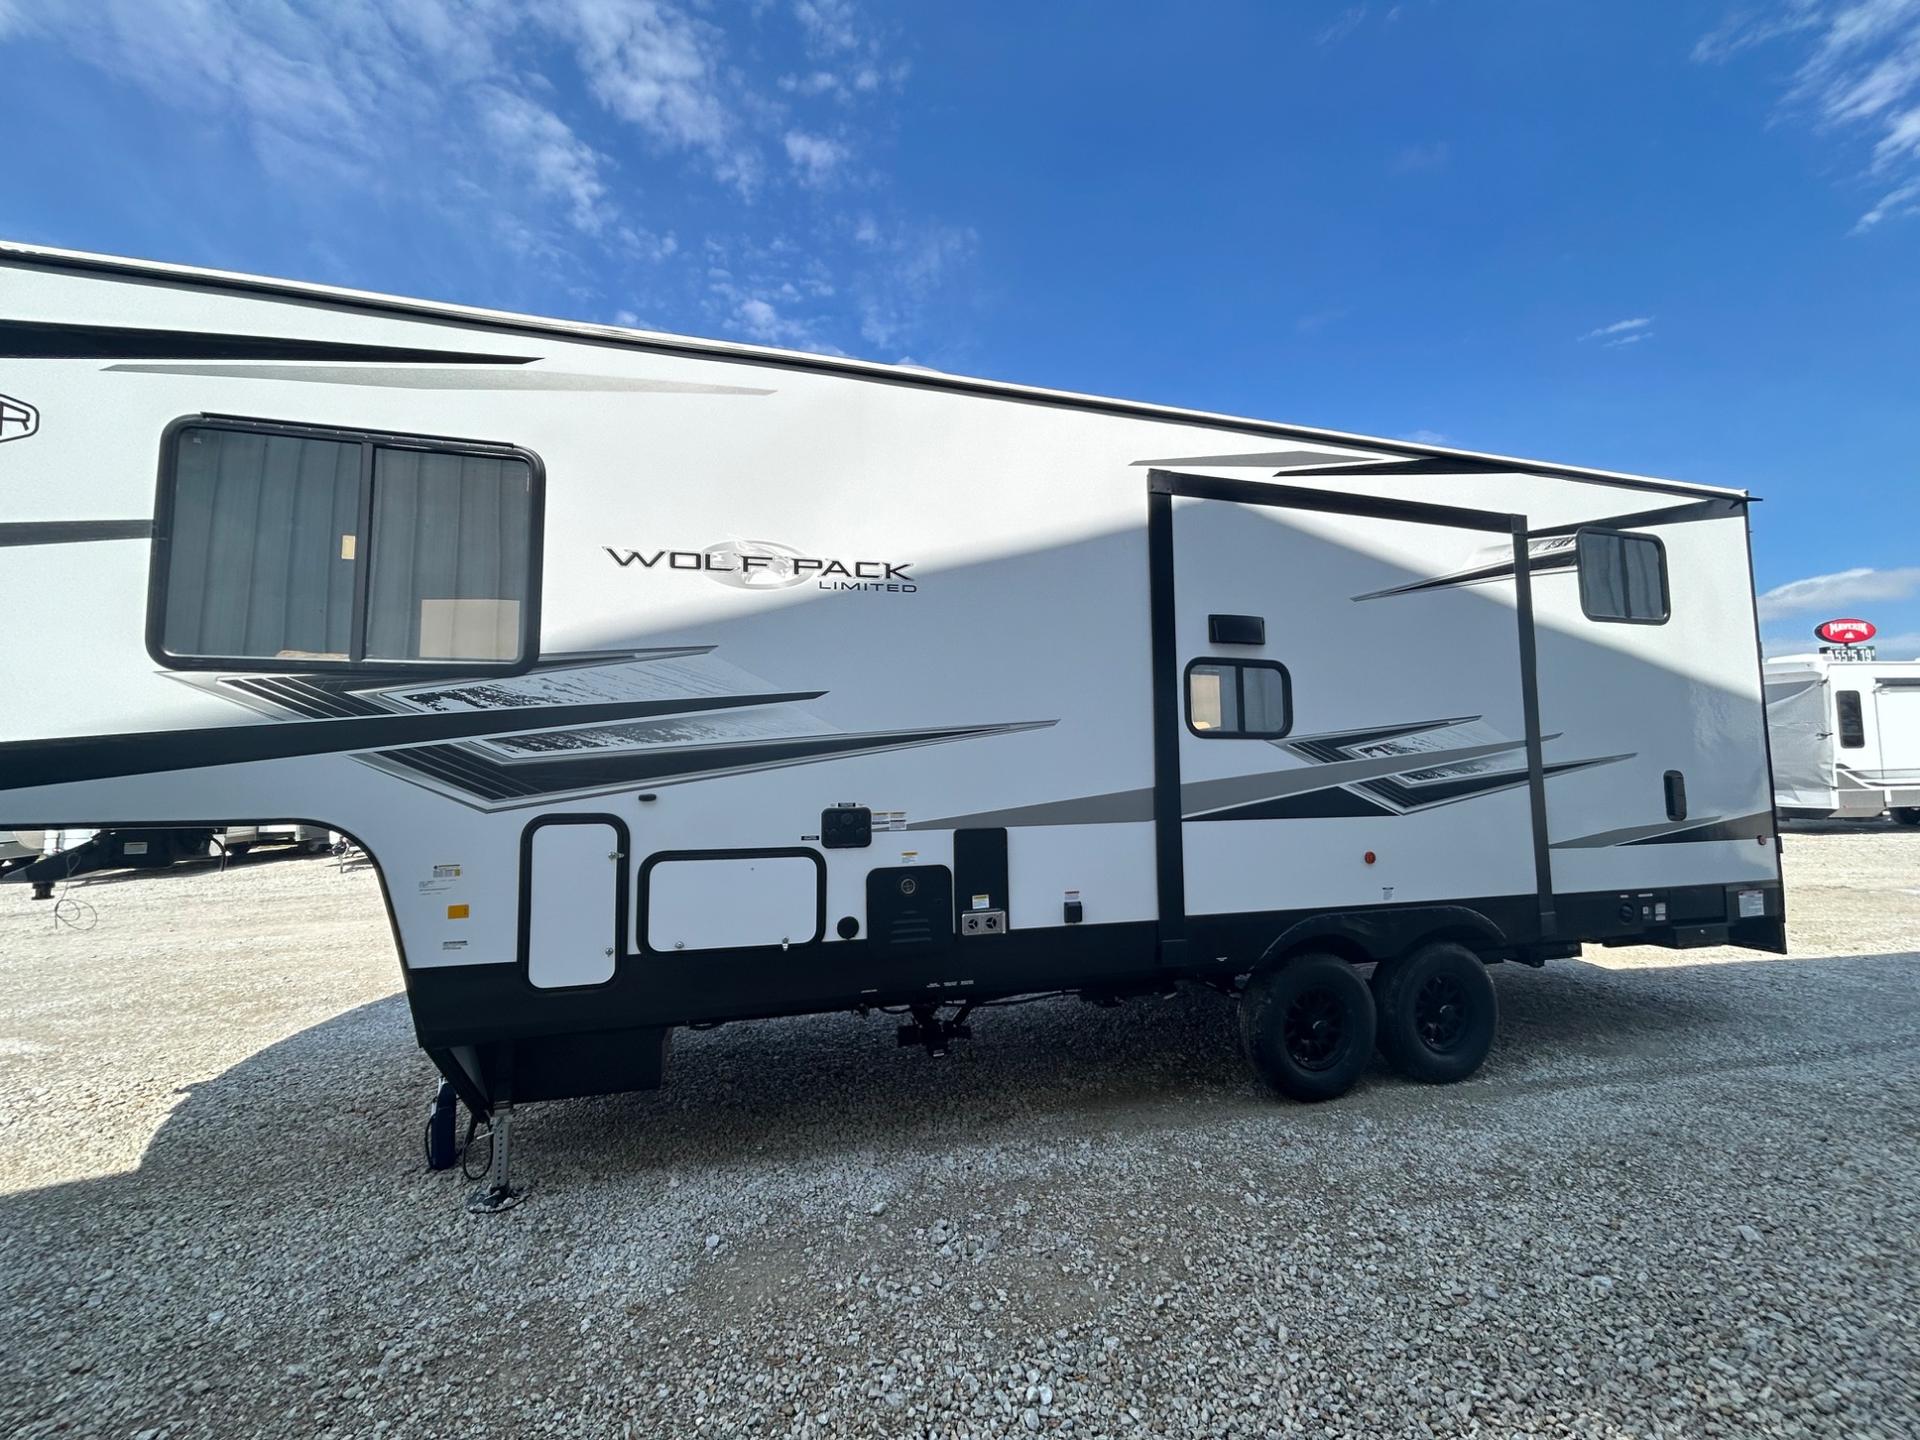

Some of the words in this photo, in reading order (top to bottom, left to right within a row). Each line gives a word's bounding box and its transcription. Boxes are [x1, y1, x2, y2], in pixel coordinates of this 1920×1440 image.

[602, 546, 773, 573] WOLF
[792, 558, 915, 581] PACK
[819, 581, 917, 593] LIMITED
